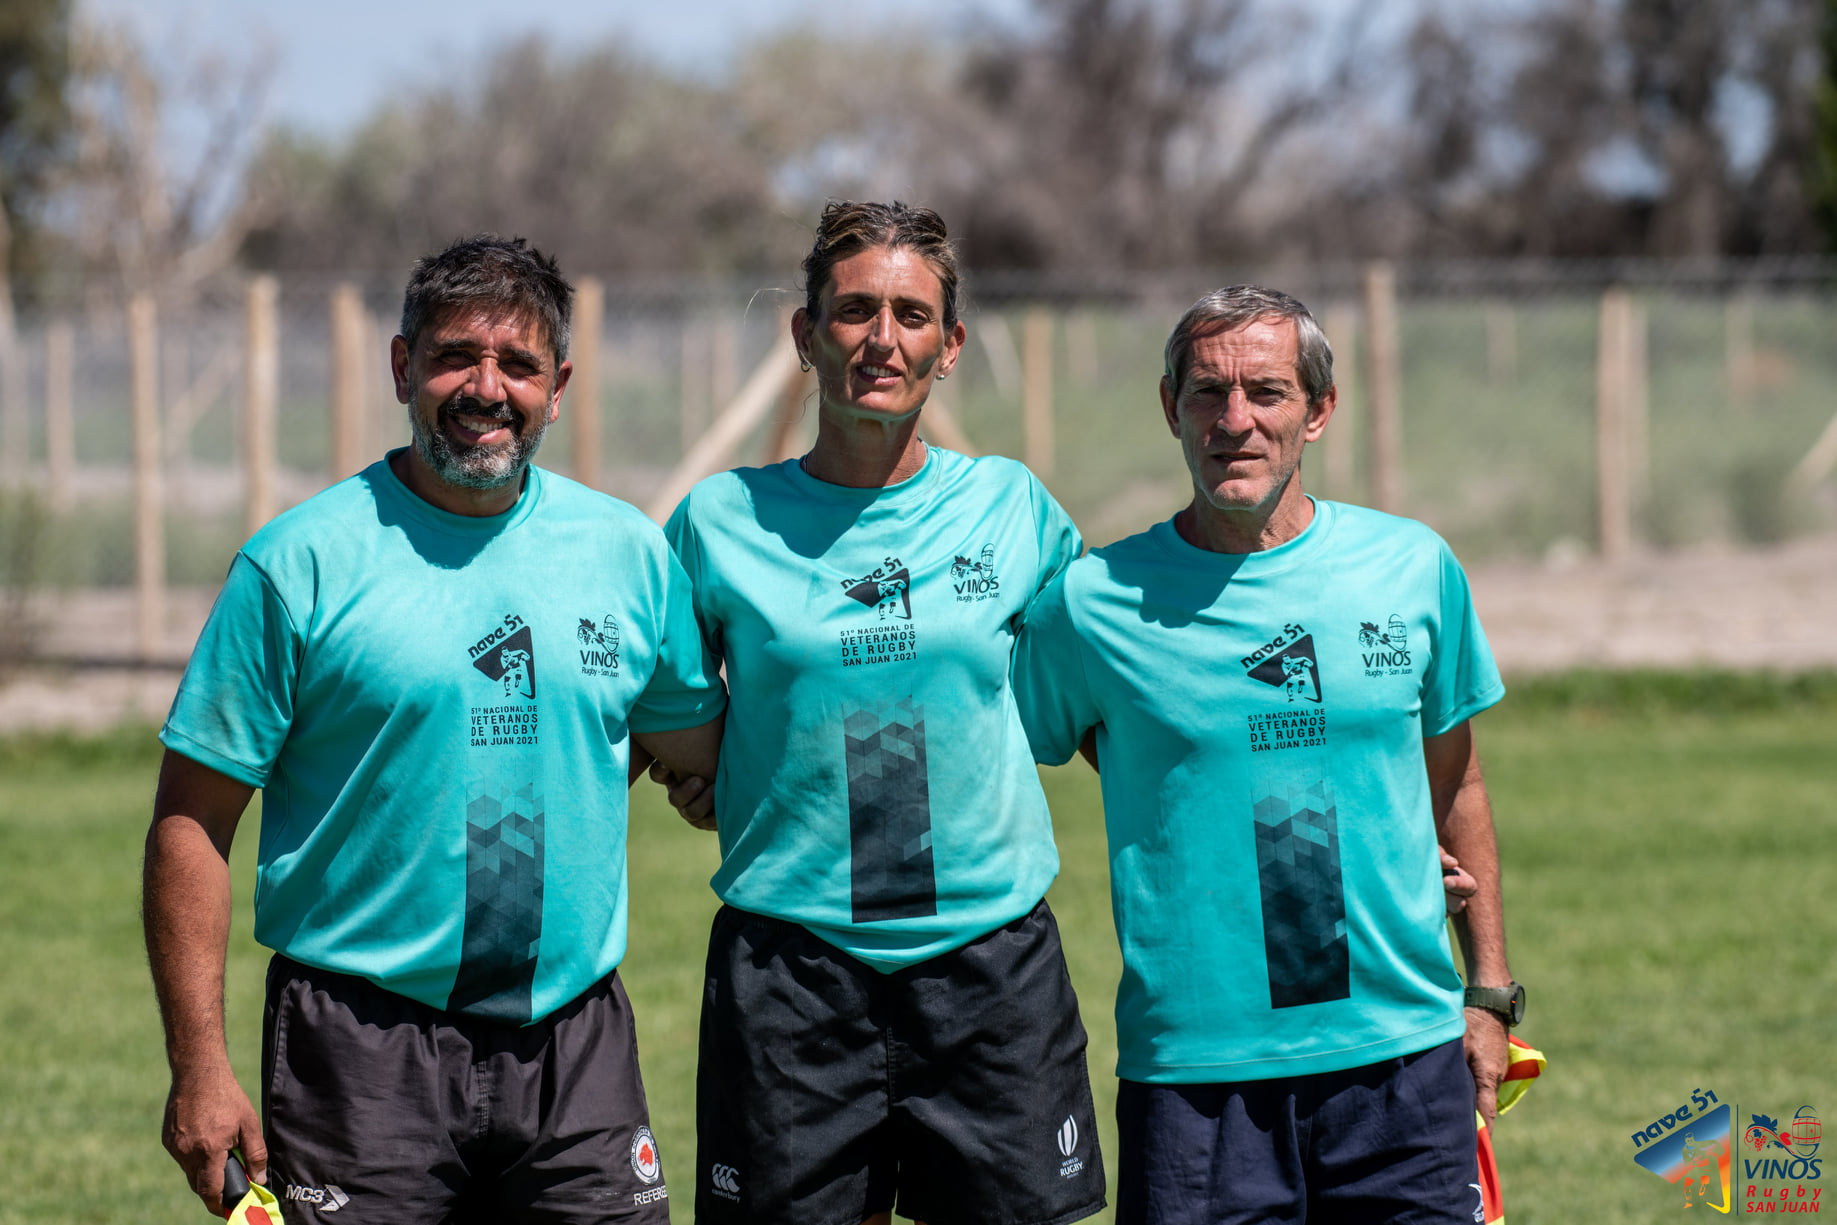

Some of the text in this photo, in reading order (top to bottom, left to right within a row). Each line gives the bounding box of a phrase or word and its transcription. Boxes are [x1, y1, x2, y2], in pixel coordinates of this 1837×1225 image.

[884, 557, 902, 572] 51
[954, 576, 999, 594] VINOS
[957, 595, 972, 603] Rugby
[468, 614, 524, 658] nave 51
[858, 625, 900, 635] NACIONAL
[841, 631, 915, 646] VETERANOS
[1240, 623, 1305, 668] nave 51
[842, 640, 915, 657] DE RUGBY
[580, 650, 619, 669] VINOS
[843, 652, 916, 667] SAN JUAN 2021
[1362, 651, 1411, 667] VINOS
[582, 667, 597, 676] Rugby
[609, 670, 619, 678] Juan
[1365, 669, 1383, 678] Rugby
[483, 706, 524, 714] NACIONAL
[1266, 711, 1310, 720] NACIONAL
[472, 714, 538, 725] VETERANOS
[1248, 717, 1325, 731] VETERANOS
[472, 725, 538, 736] DE RUGBY
[1251, 727, 1325, 742] DE RUGBY
[471, 736, 538, 746] SAN JUAN 2021
[1251, 738, 1326, 752] SAN JUAN 2021
[1060, 1161, 1082, 1176] RUGBY
[286, 1184, 324, 1203] MC3
